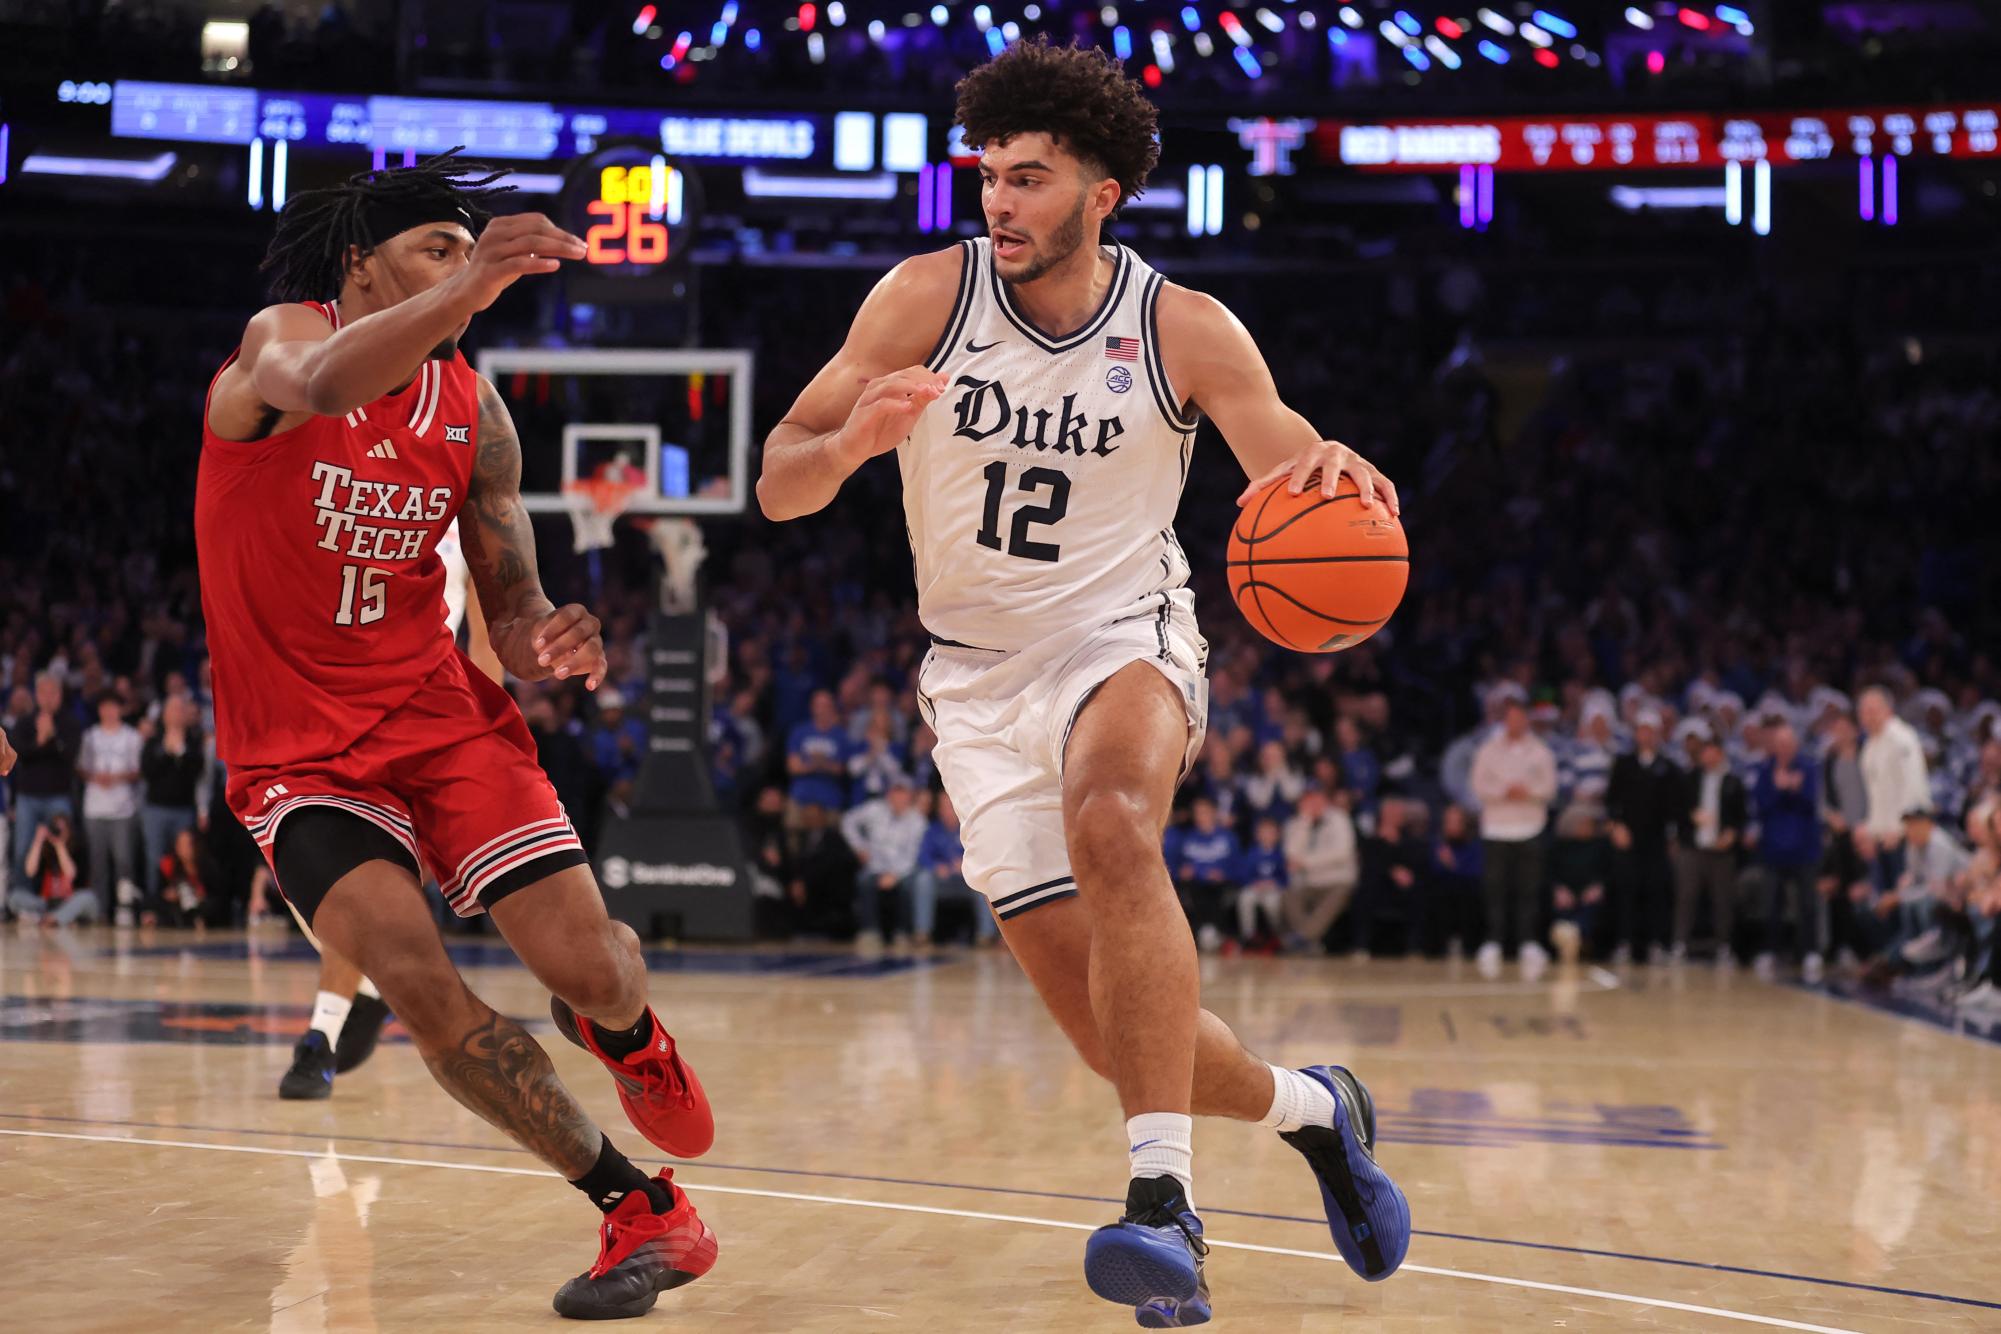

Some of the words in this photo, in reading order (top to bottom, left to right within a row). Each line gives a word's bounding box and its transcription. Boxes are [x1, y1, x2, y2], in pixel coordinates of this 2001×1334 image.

[587, 199, 668, 265] 26
[952, 375, 1125, 458] Duke
[311, 461, 452, 522] TEXAS
[976, 460, 1072, 563] 12
[315, 508, 430, 560] TECH
[335, 564, 396, 626] 15
